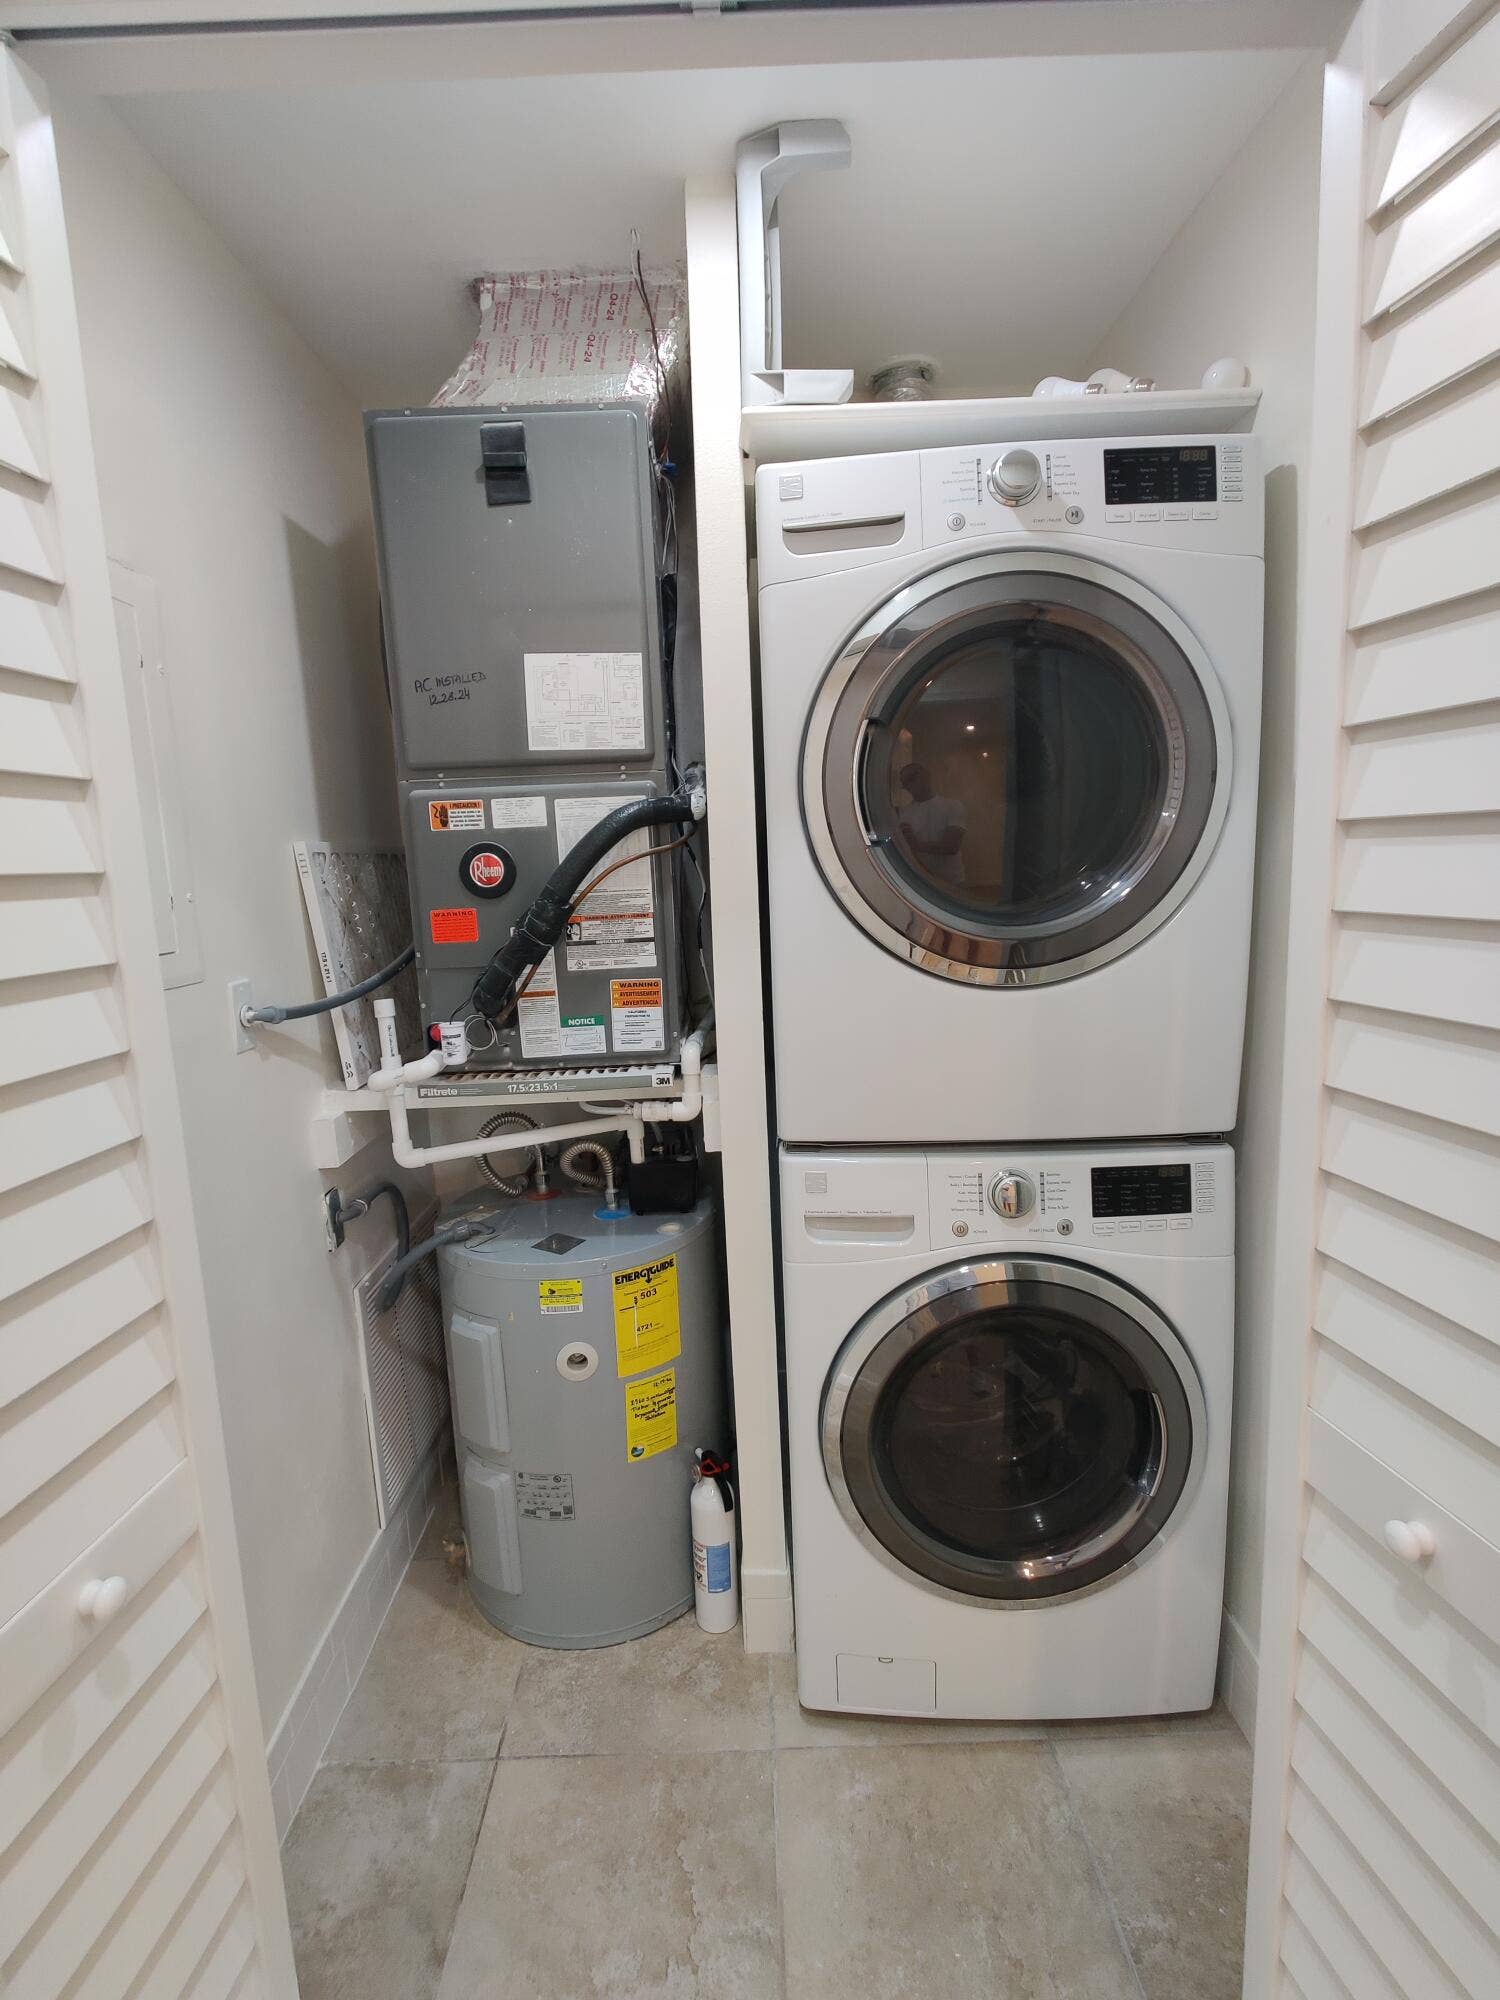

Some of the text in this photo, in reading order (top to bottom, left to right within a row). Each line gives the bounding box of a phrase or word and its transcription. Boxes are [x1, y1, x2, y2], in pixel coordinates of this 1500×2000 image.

[414, 671, 487, 693] AC INSTALLED
[473, 856, 502, 882] Rheem
[433, 910, 474, 918] WARNING
[567, 1017, 596, 1026] NOTICE
[655, 1077, 672, 1086] 3M
[640, 1287, 658, 1300] 503
